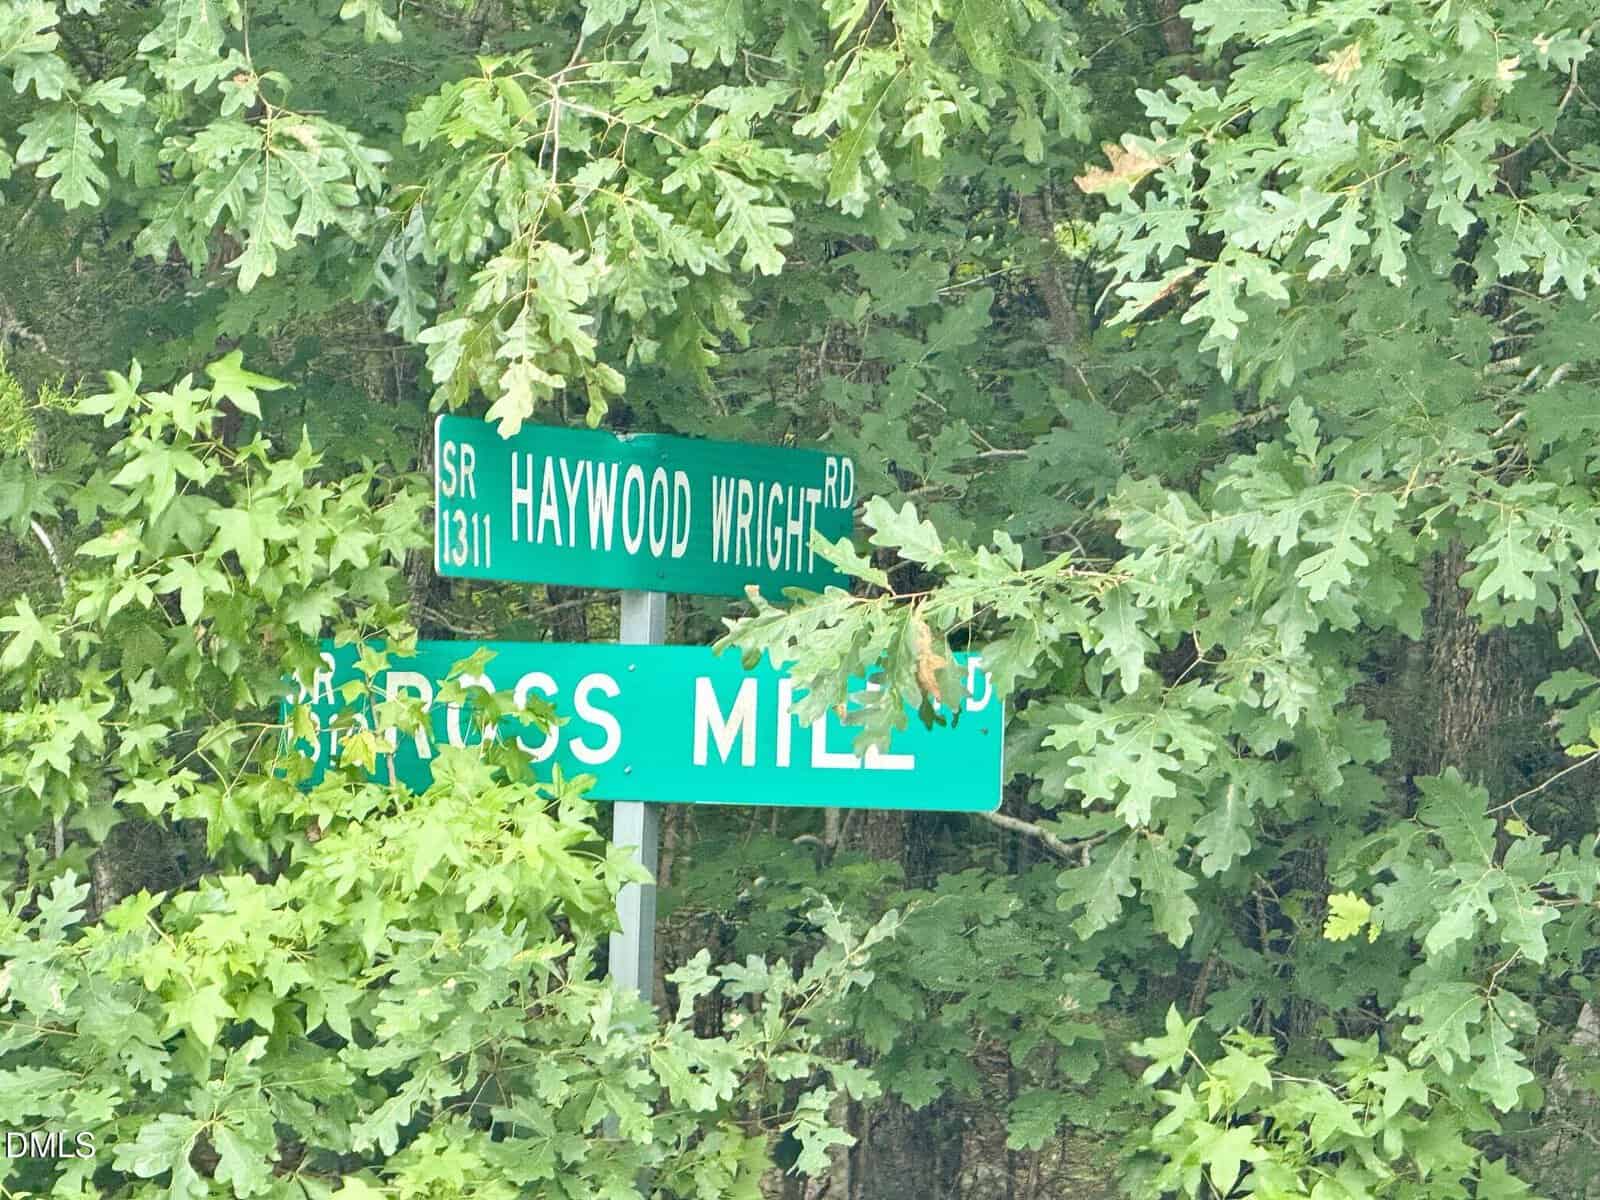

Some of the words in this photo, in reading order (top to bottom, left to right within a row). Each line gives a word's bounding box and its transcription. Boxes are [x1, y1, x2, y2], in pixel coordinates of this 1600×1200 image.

[441, 439, 477, 499] SR
[441, 508, 492, 569] 1311
[511, 450, 692, 560] HAYWOOD
[711, 473, 822, 575] WRIGHT
[824, 456, 855, 509] RD
